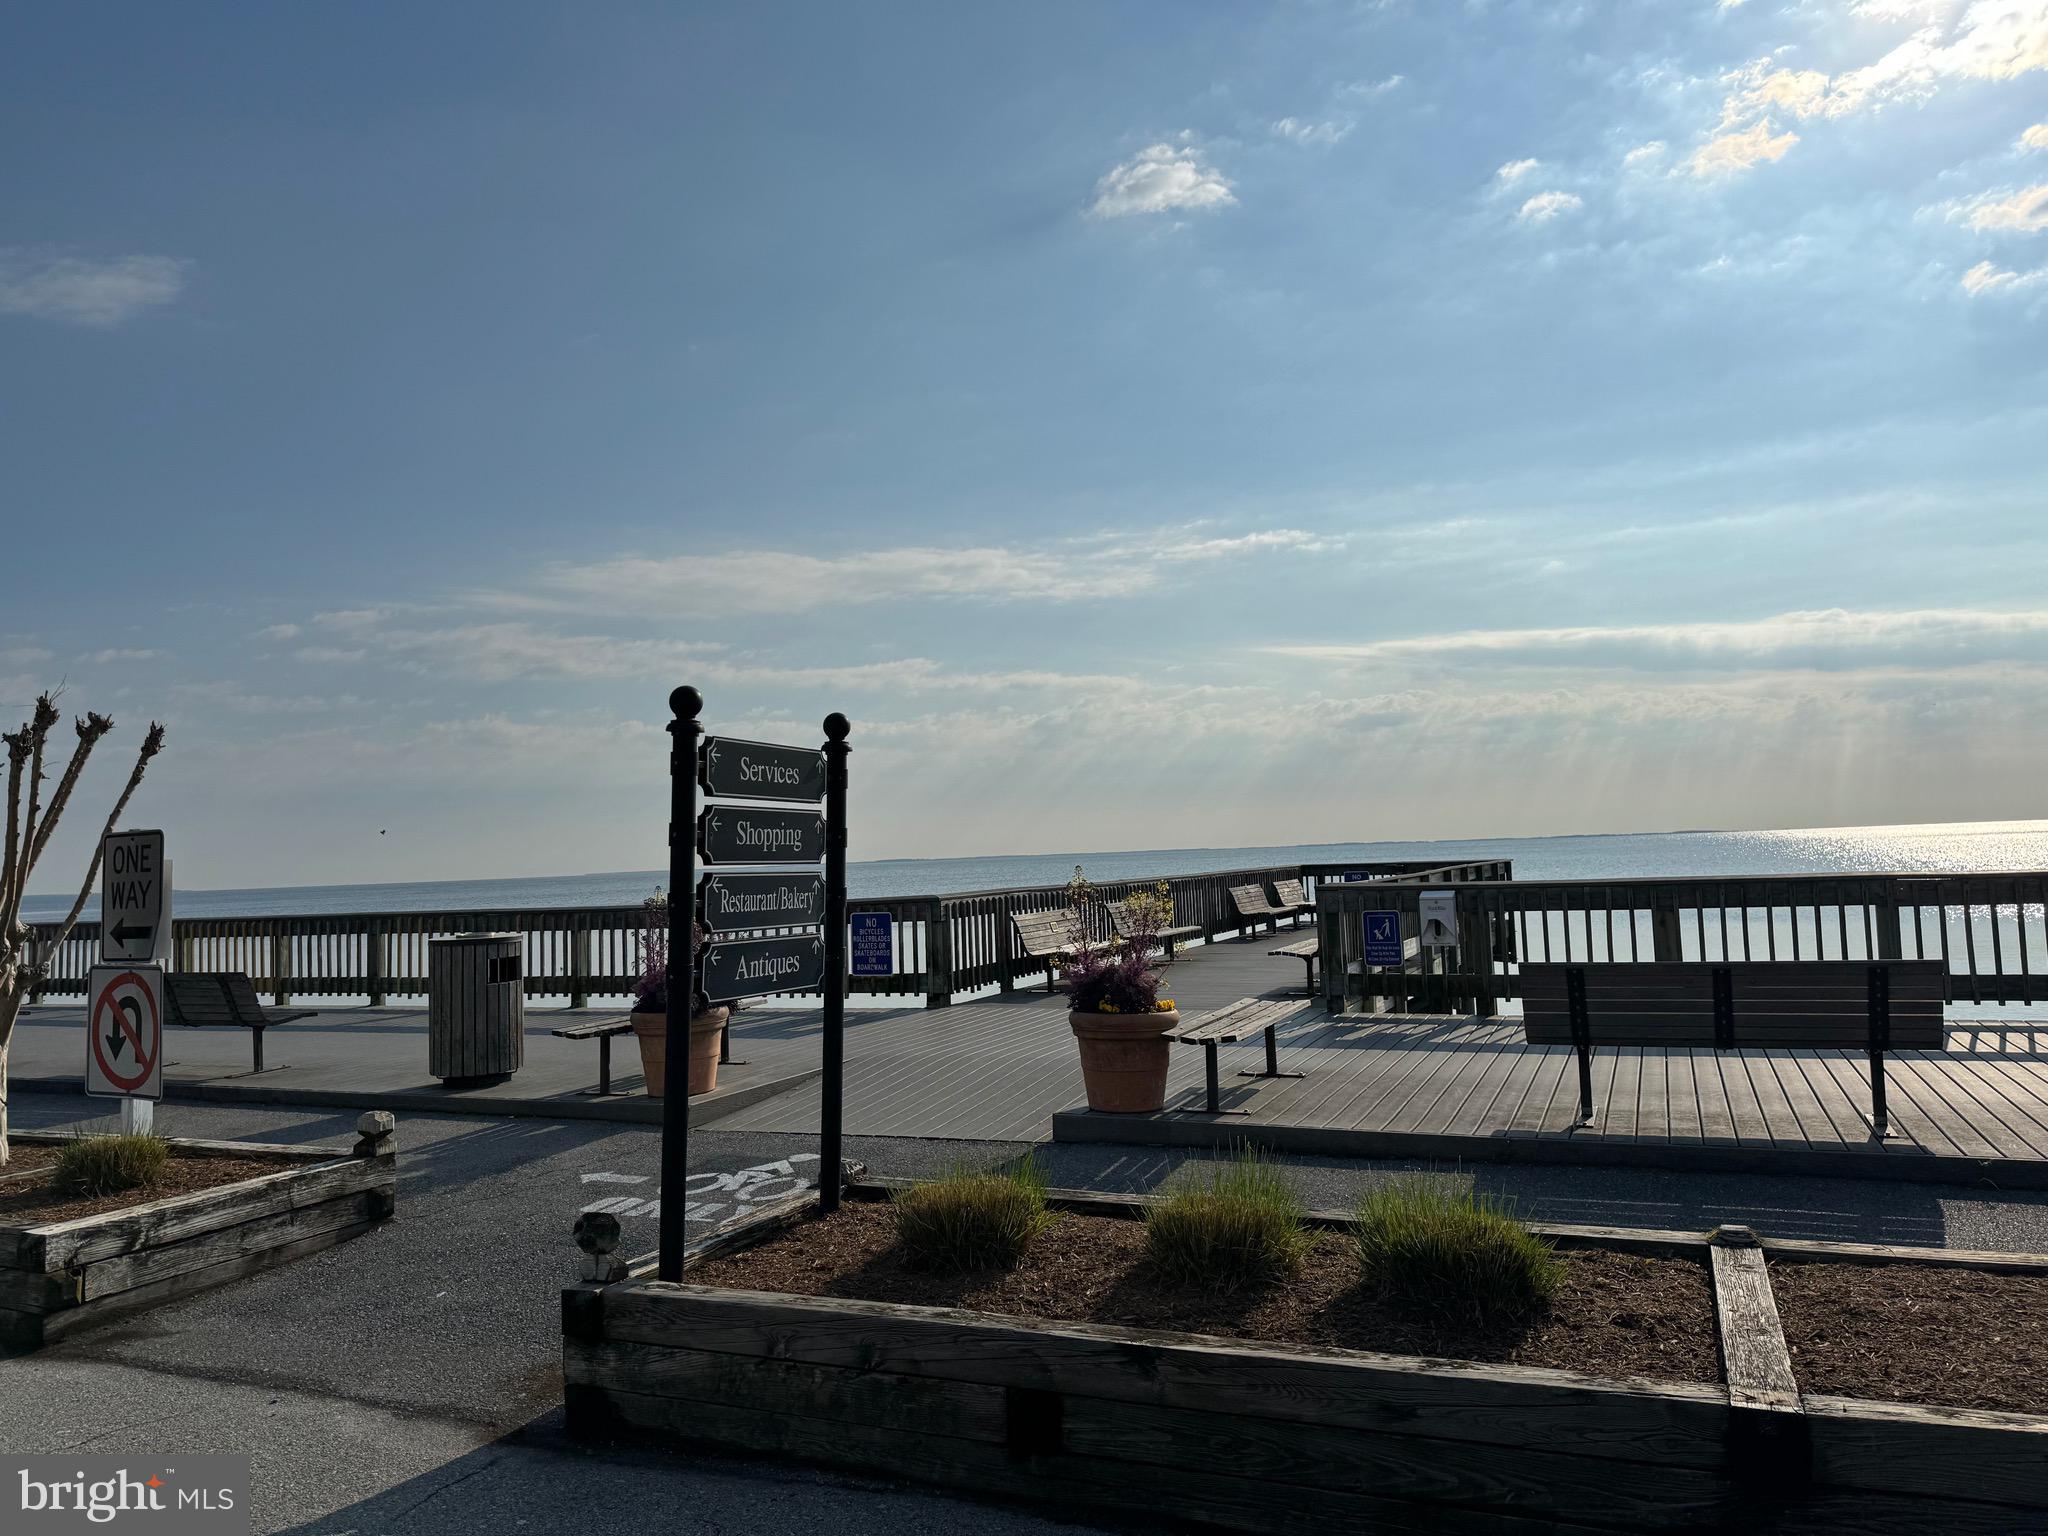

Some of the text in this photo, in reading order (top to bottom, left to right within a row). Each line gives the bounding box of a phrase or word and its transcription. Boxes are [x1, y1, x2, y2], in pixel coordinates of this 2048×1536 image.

[740, 757, 800, 785] Services
[736, 821, 802, 852] Shopping
[113, 844, 152, 874] ONE
[111, 879, 153, 910] WAY
[720, 887, 815, 915] Restaurant/Bakery
[866, 918, 876, 928] NO
[735, 952, 800, 982] Antiques
